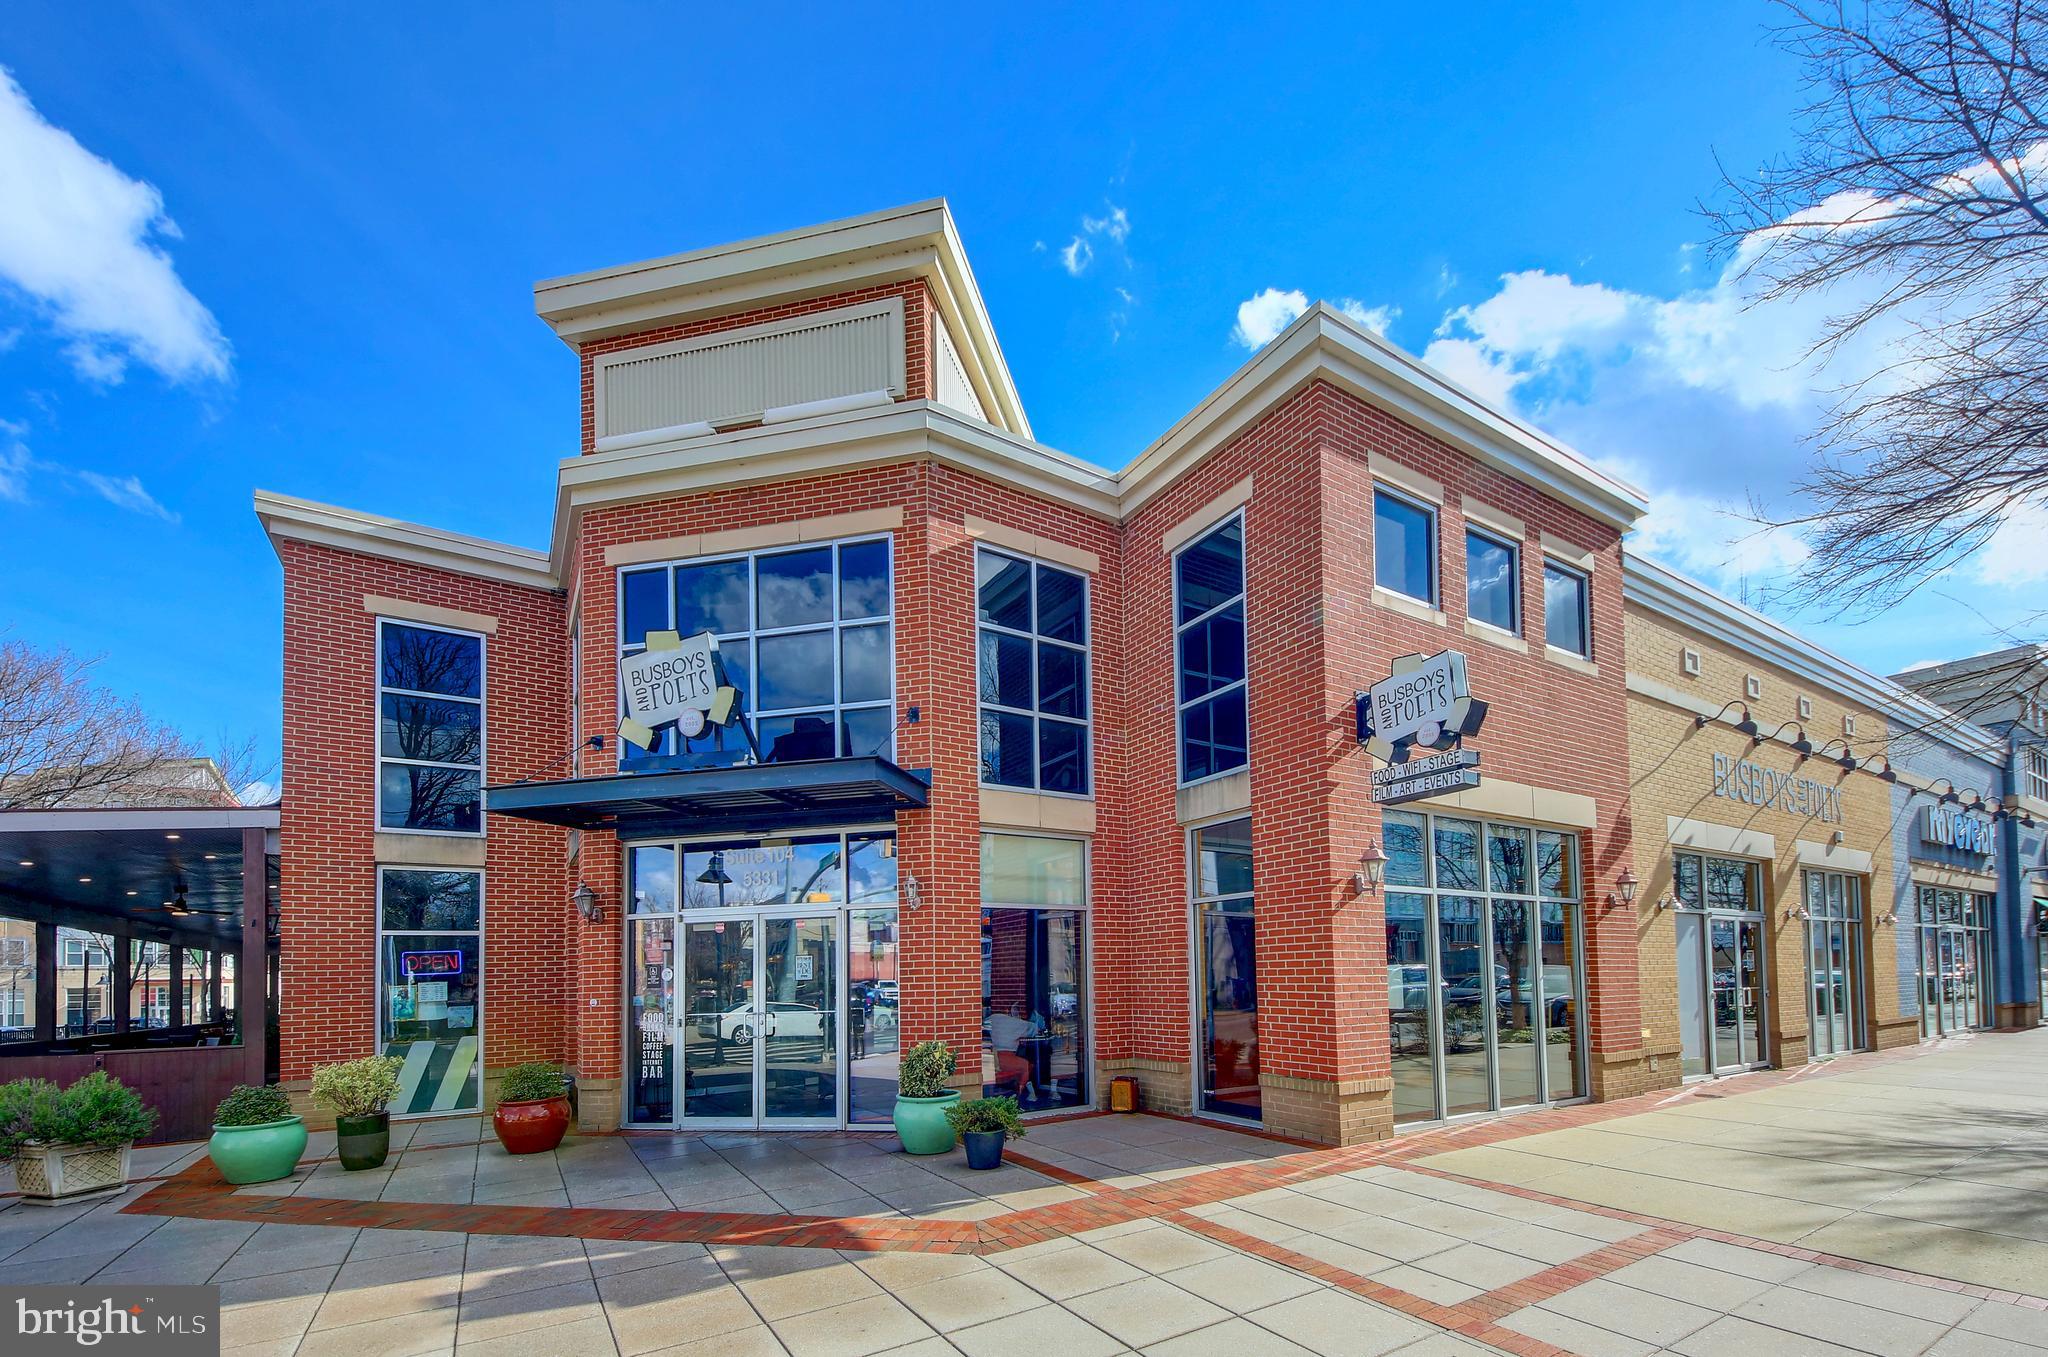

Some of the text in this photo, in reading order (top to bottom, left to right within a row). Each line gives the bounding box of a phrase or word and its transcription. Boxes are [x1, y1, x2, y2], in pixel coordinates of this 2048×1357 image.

[631, 651, 706, 687] BUSBOYS
[635, 669, 710, 712] AND POETS
[1378, 668, 1445, 709] BUSBOYS
[1381, 684, 1448, 730] AND POETS
[1373, 768, 1396, 784] FOOD
[1402, 761, 1422, 777] WIFI
[1428, 750, 1461, 771] STAGE
[1374, 786, 1393, 801] FILM
[1399, 780, 1416, 795] ART
[1424, 770, 1461, 791] EVENTS
[1713, 752, 1796, 814] BUSBOYS
[725, 846, 794, 865] Suite 104
[743, 869, 781, 887] 5331
[406, 955, 458, 970] OPEN
[642, 1012, 664, 1023] FOOD
[642, 1031, 664, 1042] FILM
[642, 1042, 663, 1050] COFFEE
[642, 1051, 663, 1059] STAGE
[642, 1065, 663, 1079] BAR
